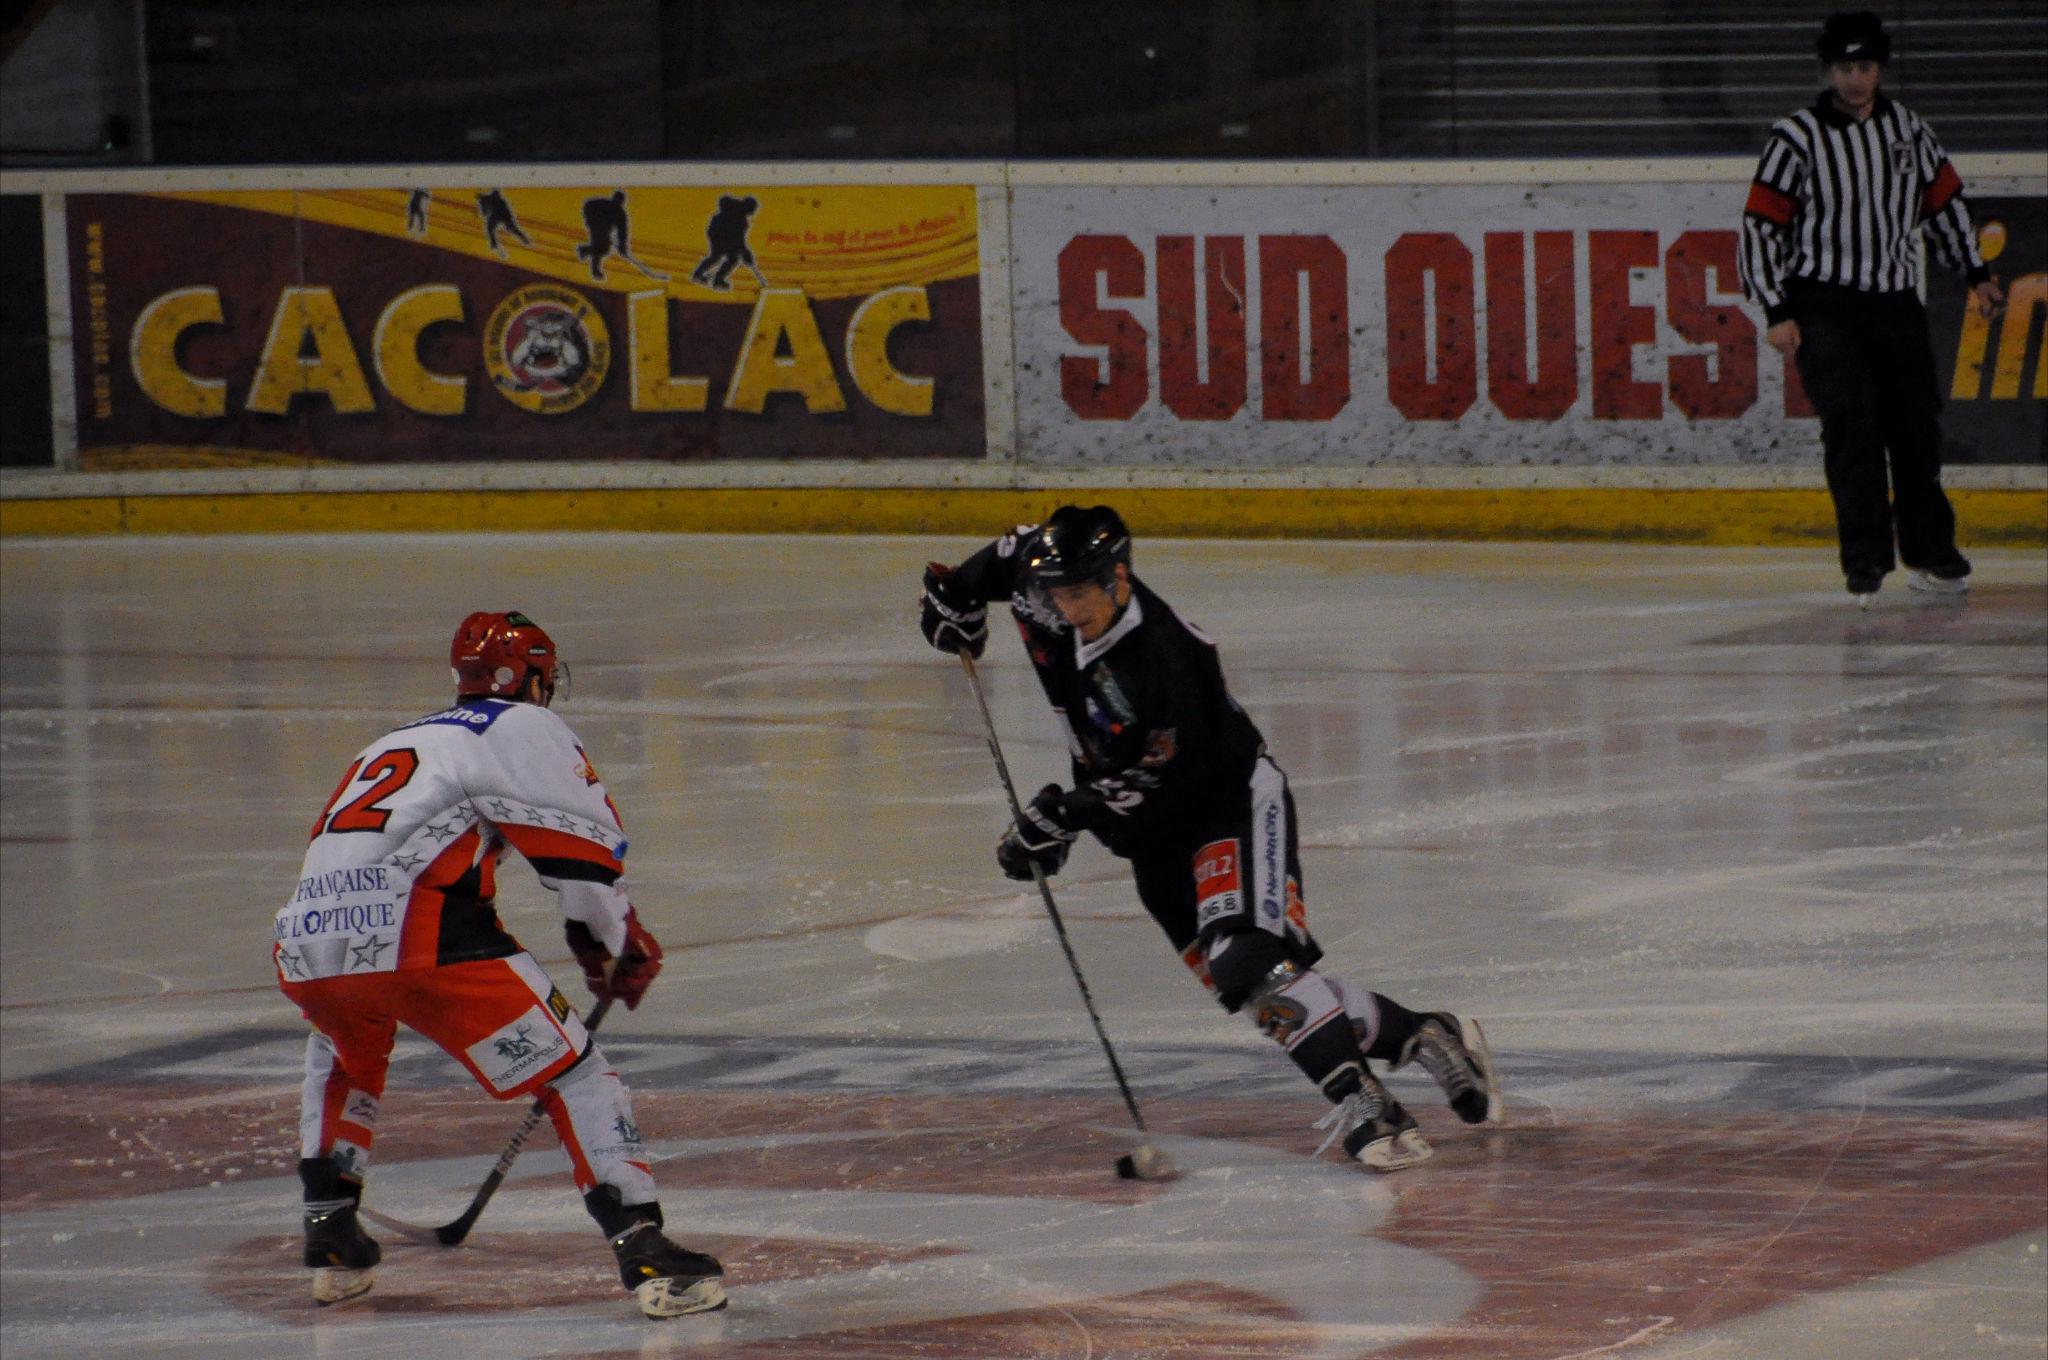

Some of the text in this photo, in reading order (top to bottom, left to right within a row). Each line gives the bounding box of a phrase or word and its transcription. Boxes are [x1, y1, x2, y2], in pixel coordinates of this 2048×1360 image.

[1058, 230, 1820, 421] SUD OUES
[296, 866, 389, 902] FRANÇAISE
